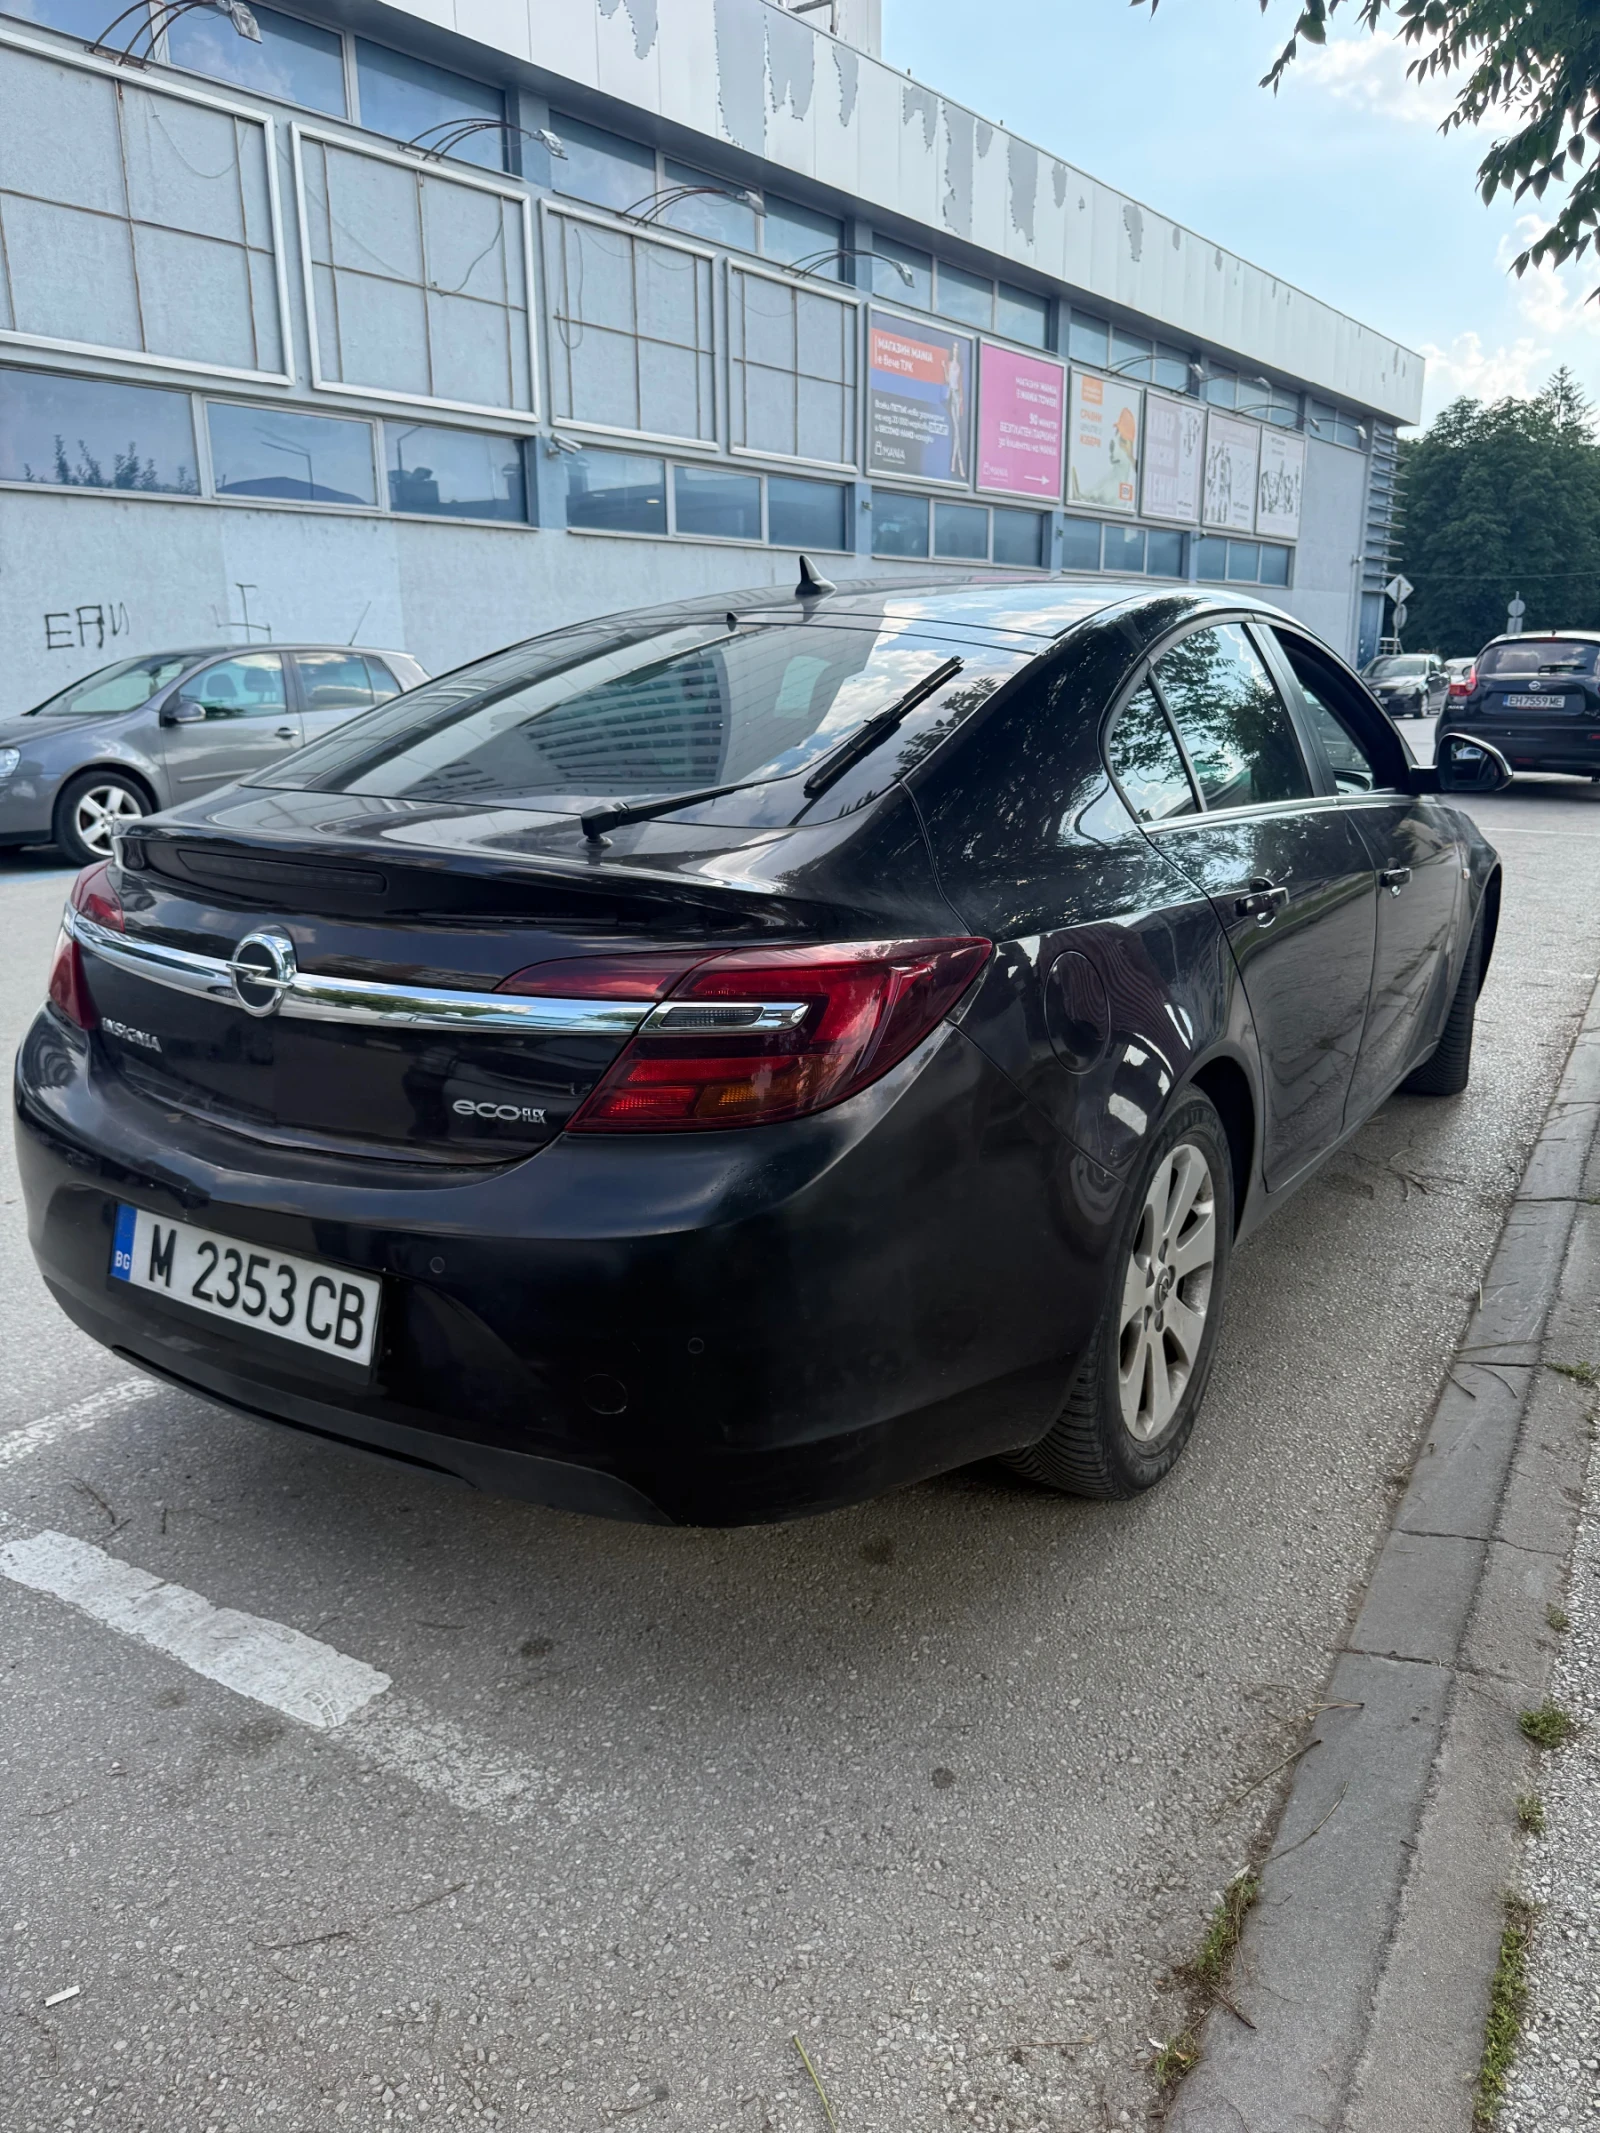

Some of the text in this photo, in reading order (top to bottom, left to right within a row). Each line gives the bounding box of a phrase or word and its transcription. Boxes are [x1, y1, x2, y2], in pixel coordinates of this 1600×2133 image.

[877, 337, 934, 363] МАГАЗИН MANIA
[882, 446, 906, 460] MANIA
[1524, 695, 1548, 706] 7559
[102, 1016, 162, 1053] INSIGNIA
[114, 1250, 132, 1271] BG
[148, 1223, 366, 1350] M 2353 CB
